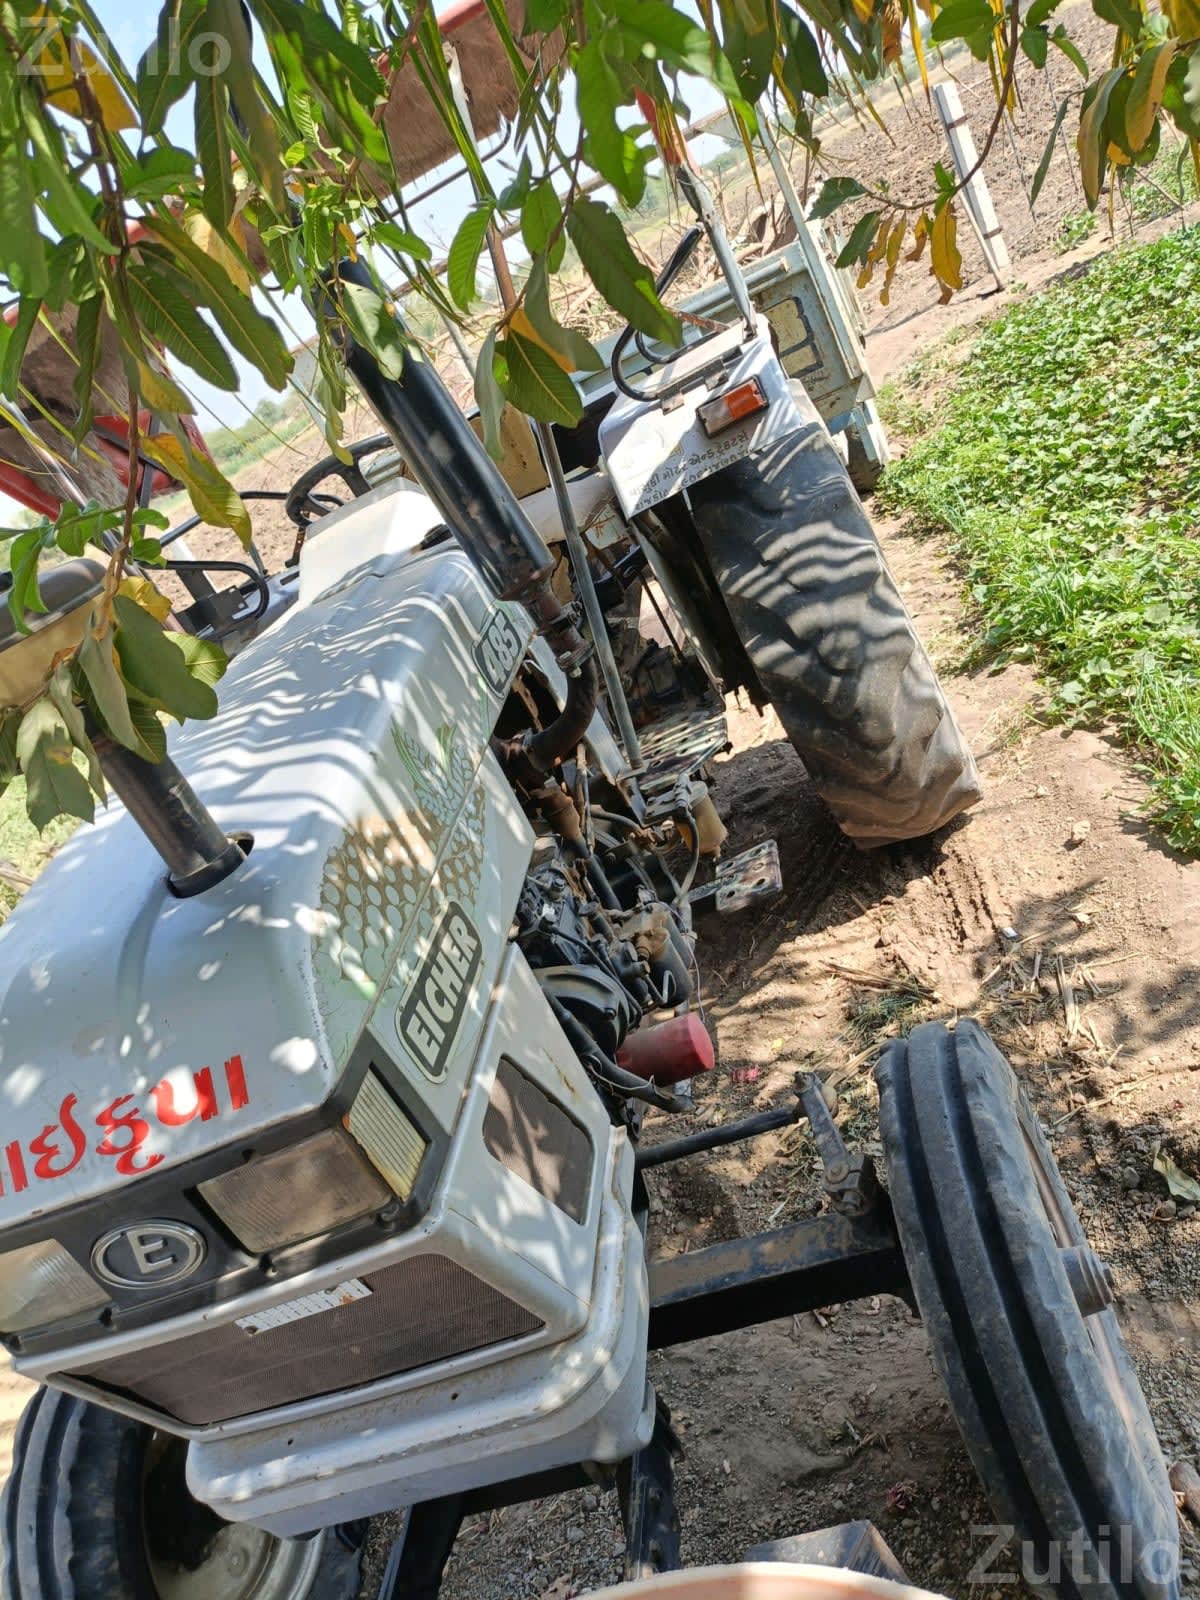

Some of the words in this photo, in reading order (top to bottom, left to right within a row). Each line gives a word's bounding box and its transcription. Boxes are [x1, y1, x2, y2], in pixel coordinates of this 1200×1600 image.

[482, 613, 519, 685] 485
[406, 915, 478, 1067] EICHER
[0, 1055, 249, 1192] ાઈકૃપા
